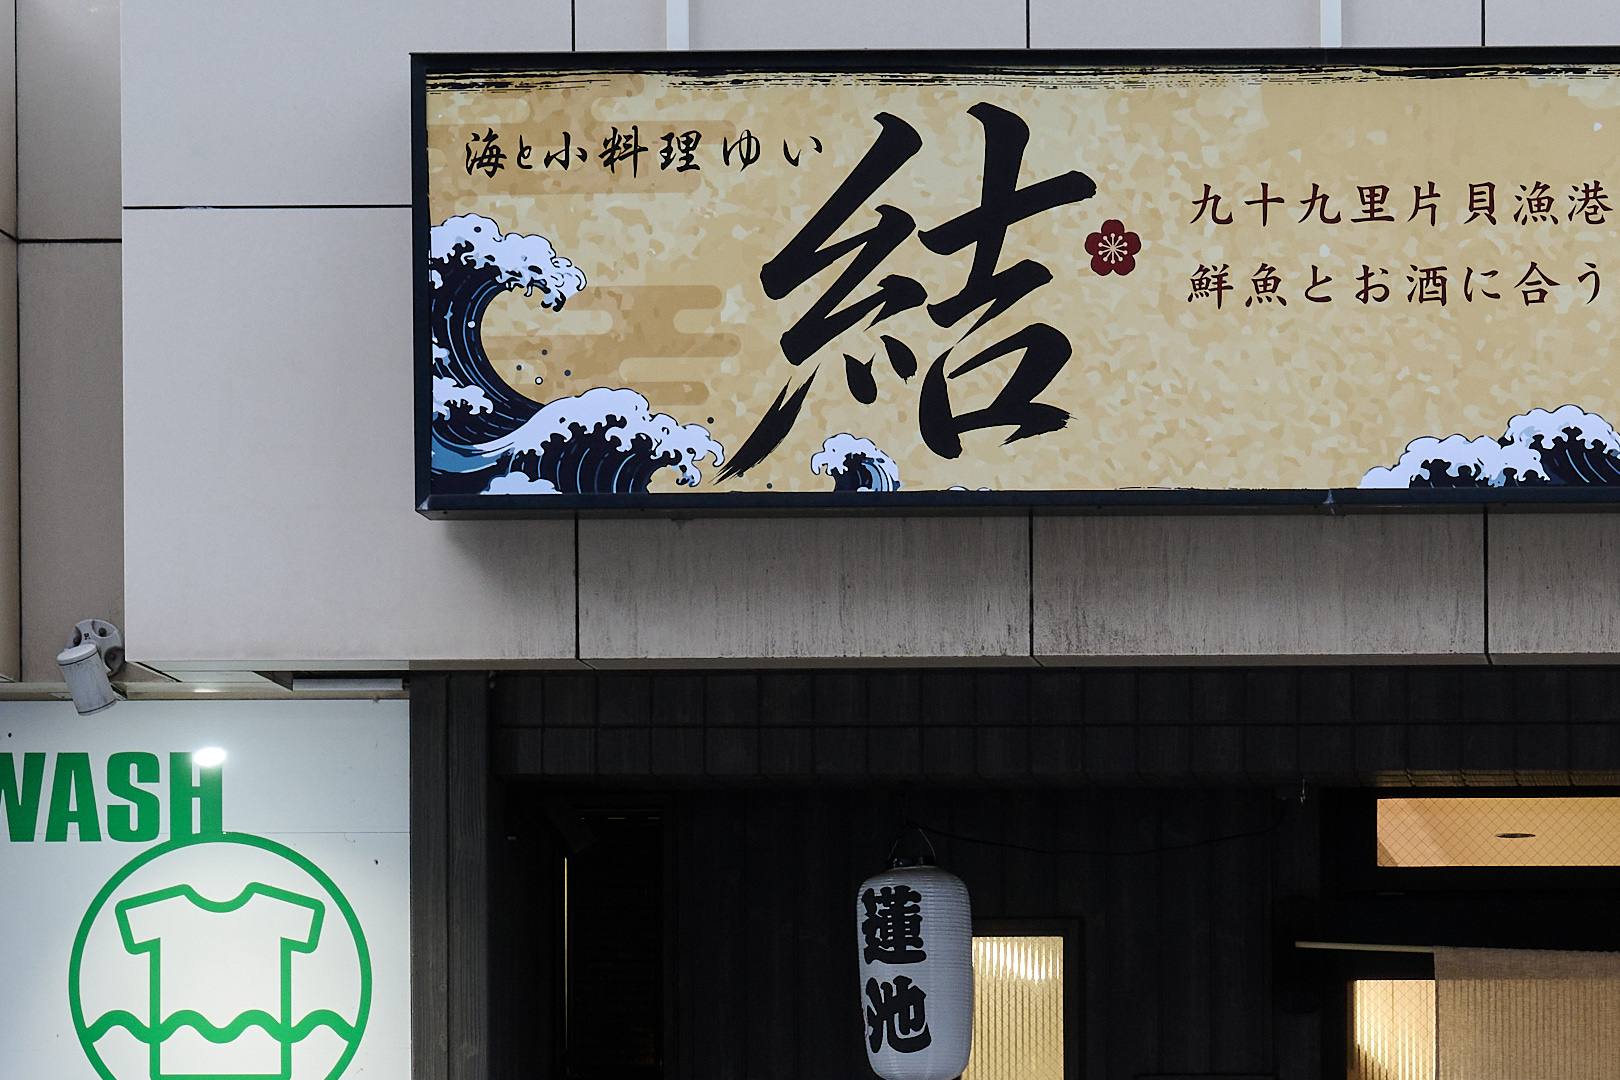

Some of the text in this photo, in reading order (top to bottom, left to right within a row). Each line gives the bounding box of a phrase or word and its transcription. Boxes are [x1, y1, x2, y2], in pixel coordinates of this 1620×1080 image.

[463, 124, 823, 178] 海と小料理ゆい
[715, 101, 1098, 484] 結
[861, 885, 932, 1054] 蓮池
